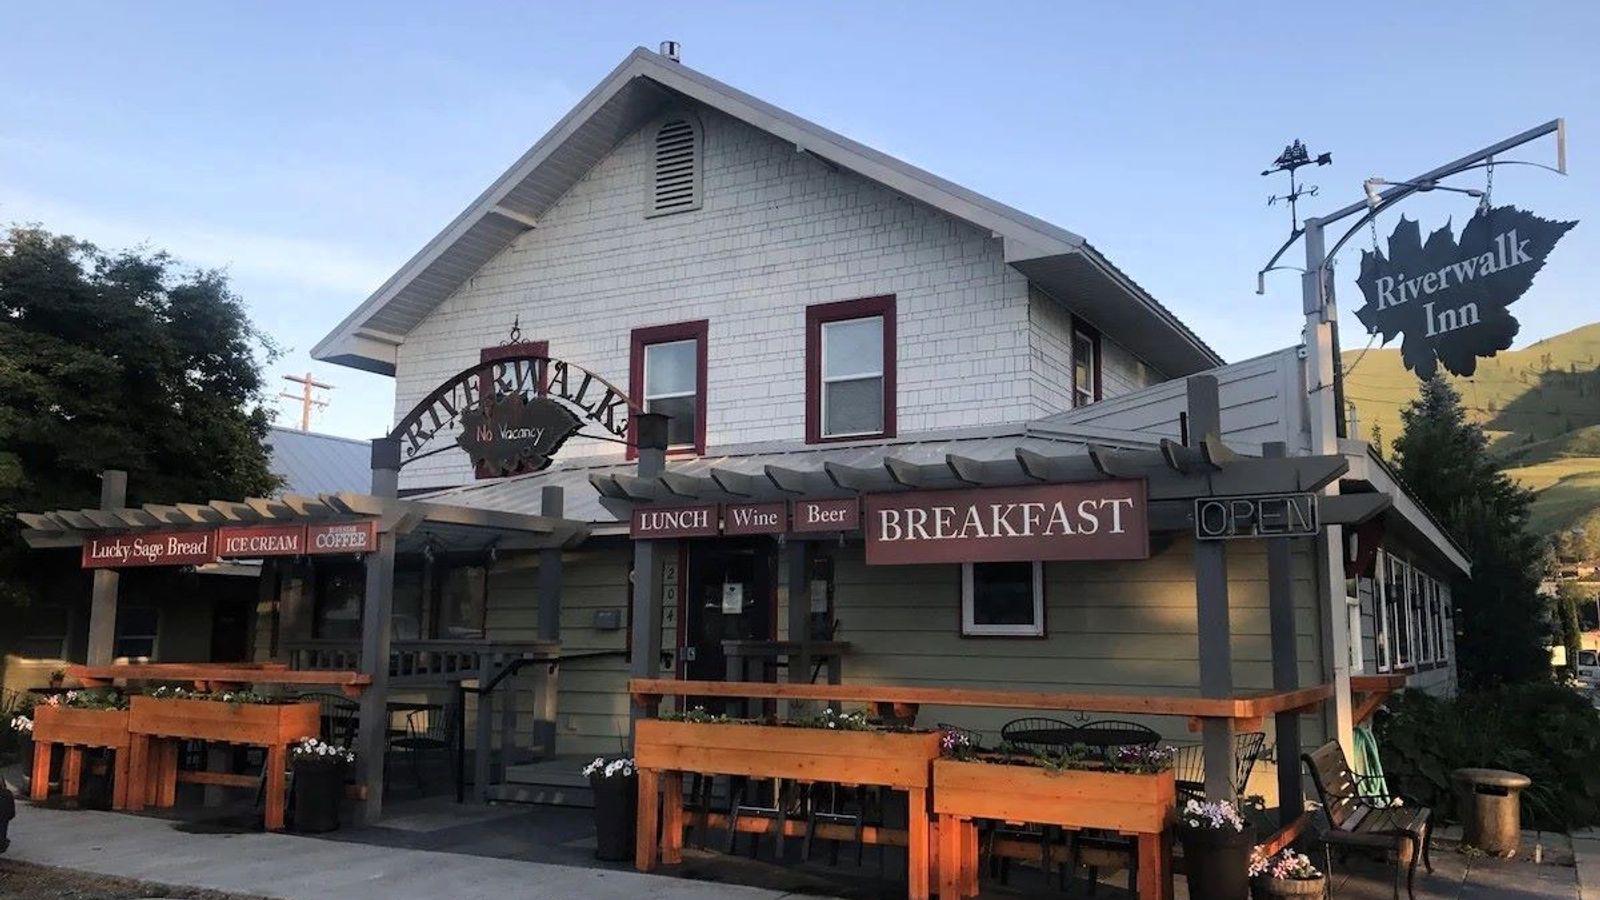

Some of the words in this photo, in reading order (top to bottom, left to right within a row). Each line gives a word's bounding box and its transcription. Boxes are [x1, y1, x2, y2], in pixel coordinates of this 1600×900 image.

[1375, 229, 1534, 311] Riverwalk
[1422, 300, 1480, 338] Inn
[407, 359, 629, 456] RIVERWALK
[476, 424, 494, 442] No
[499, 422, 545, 446] Vacancy
[640, 510, 708, 530] LUNCH
[732, 508, 778, 527] Wine
[807, 504, 847, 523] Beer
[878, 498, 1133, 541] BREAKFAST
[1201, 498, 1313, 536] OPEN
[91, 539, 131, 563] Lucky
[132, 538, 164, 562] Sage
[166, 535, 208, 555] Bread
[226, 537, 250, 552] ICE
[250, 535, 298, 551] CREAM
[316, 531, 367, 548] COFFEE
